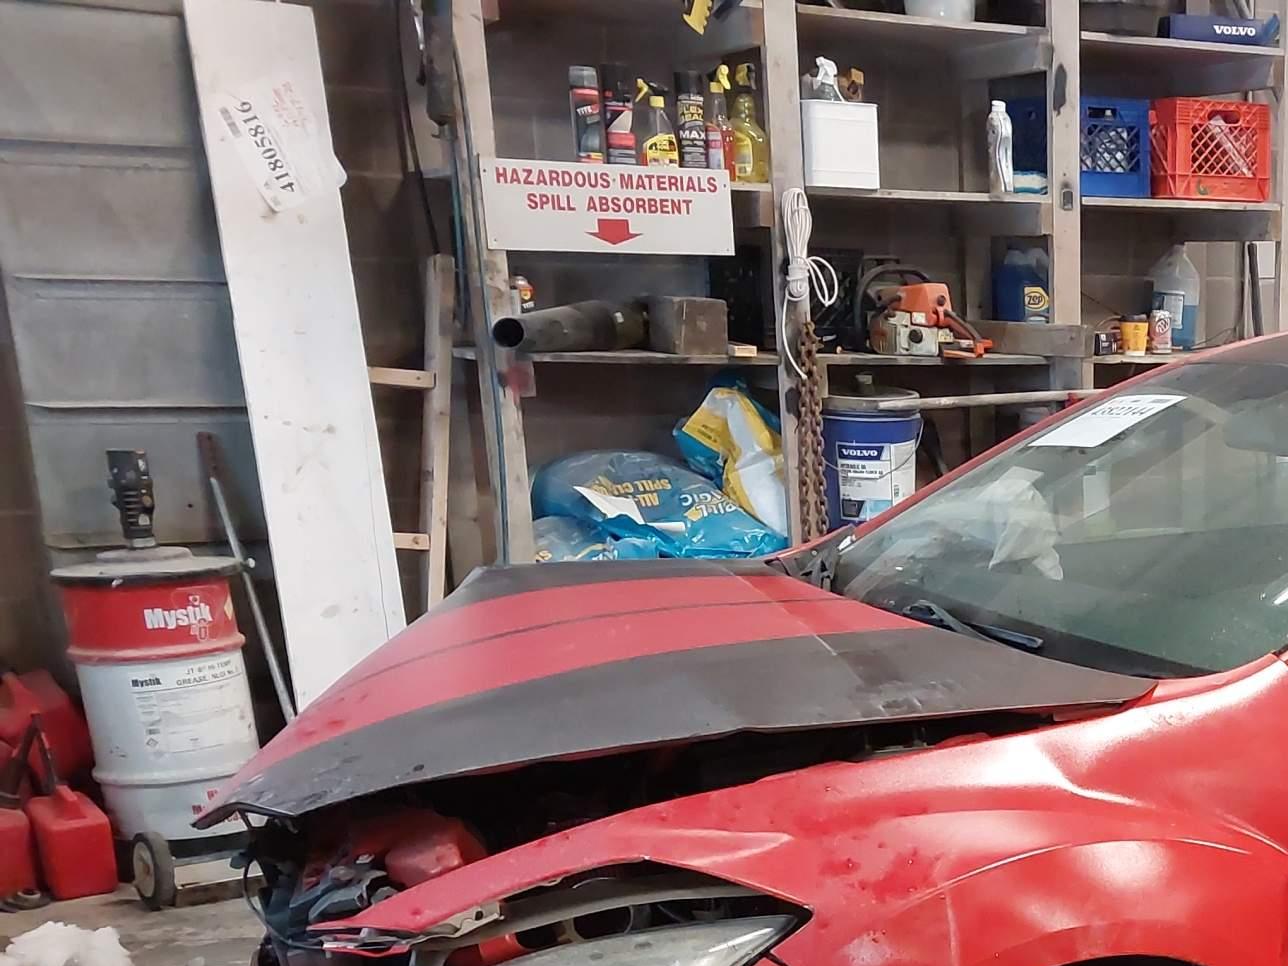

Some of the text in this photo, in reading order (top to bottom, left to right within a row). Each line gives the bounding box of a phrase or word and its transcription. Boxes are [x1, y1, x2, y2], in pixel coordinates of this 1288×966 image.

[1213, 25, 1256, 36] VOLVO
[680, 130, 706, 139] MAX
[234, 101, 295, 192] 41805816
[496, 167, 718, 193] HAZARDOUS MATERIALS
[527, 193, 693, 215] SPILL ABSORBENT
[841, 449, 878, 457] VOLVO
[634, 479, 672, 491] SPILL
[143, 602, 213, 630] Mystik
[131, 677, 162, 688] Mystik
